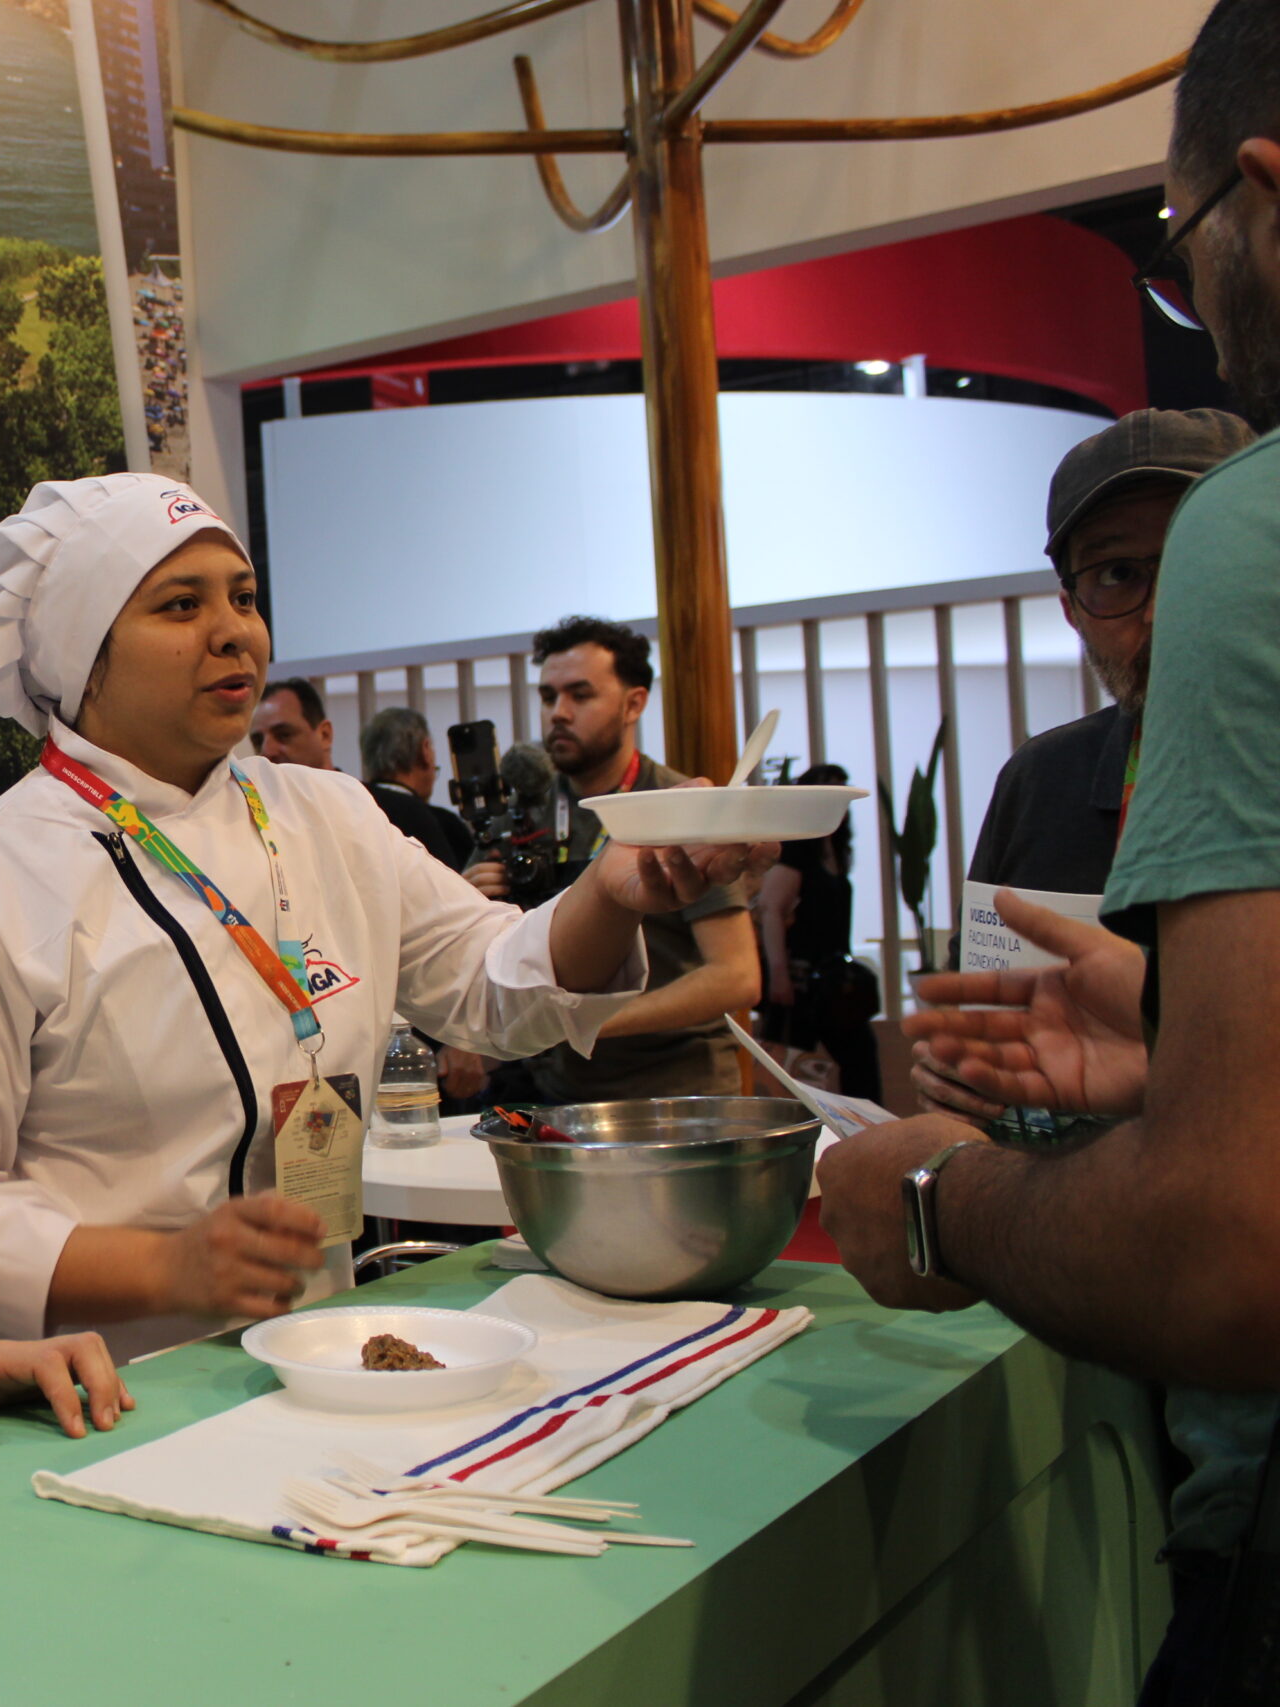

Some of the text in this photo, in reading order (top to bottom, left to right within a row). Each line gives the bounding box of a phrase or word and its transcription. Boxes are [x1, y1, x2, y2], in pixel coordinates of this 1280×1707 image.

[62, 767, 104, 800] INDESCRIPTIBLE
[970, 908, 998, 926] VUELOS
[968, 929, 1021, 952] FACILITAN LA
[967, 951, 1010, 972] CONEXIÓN
